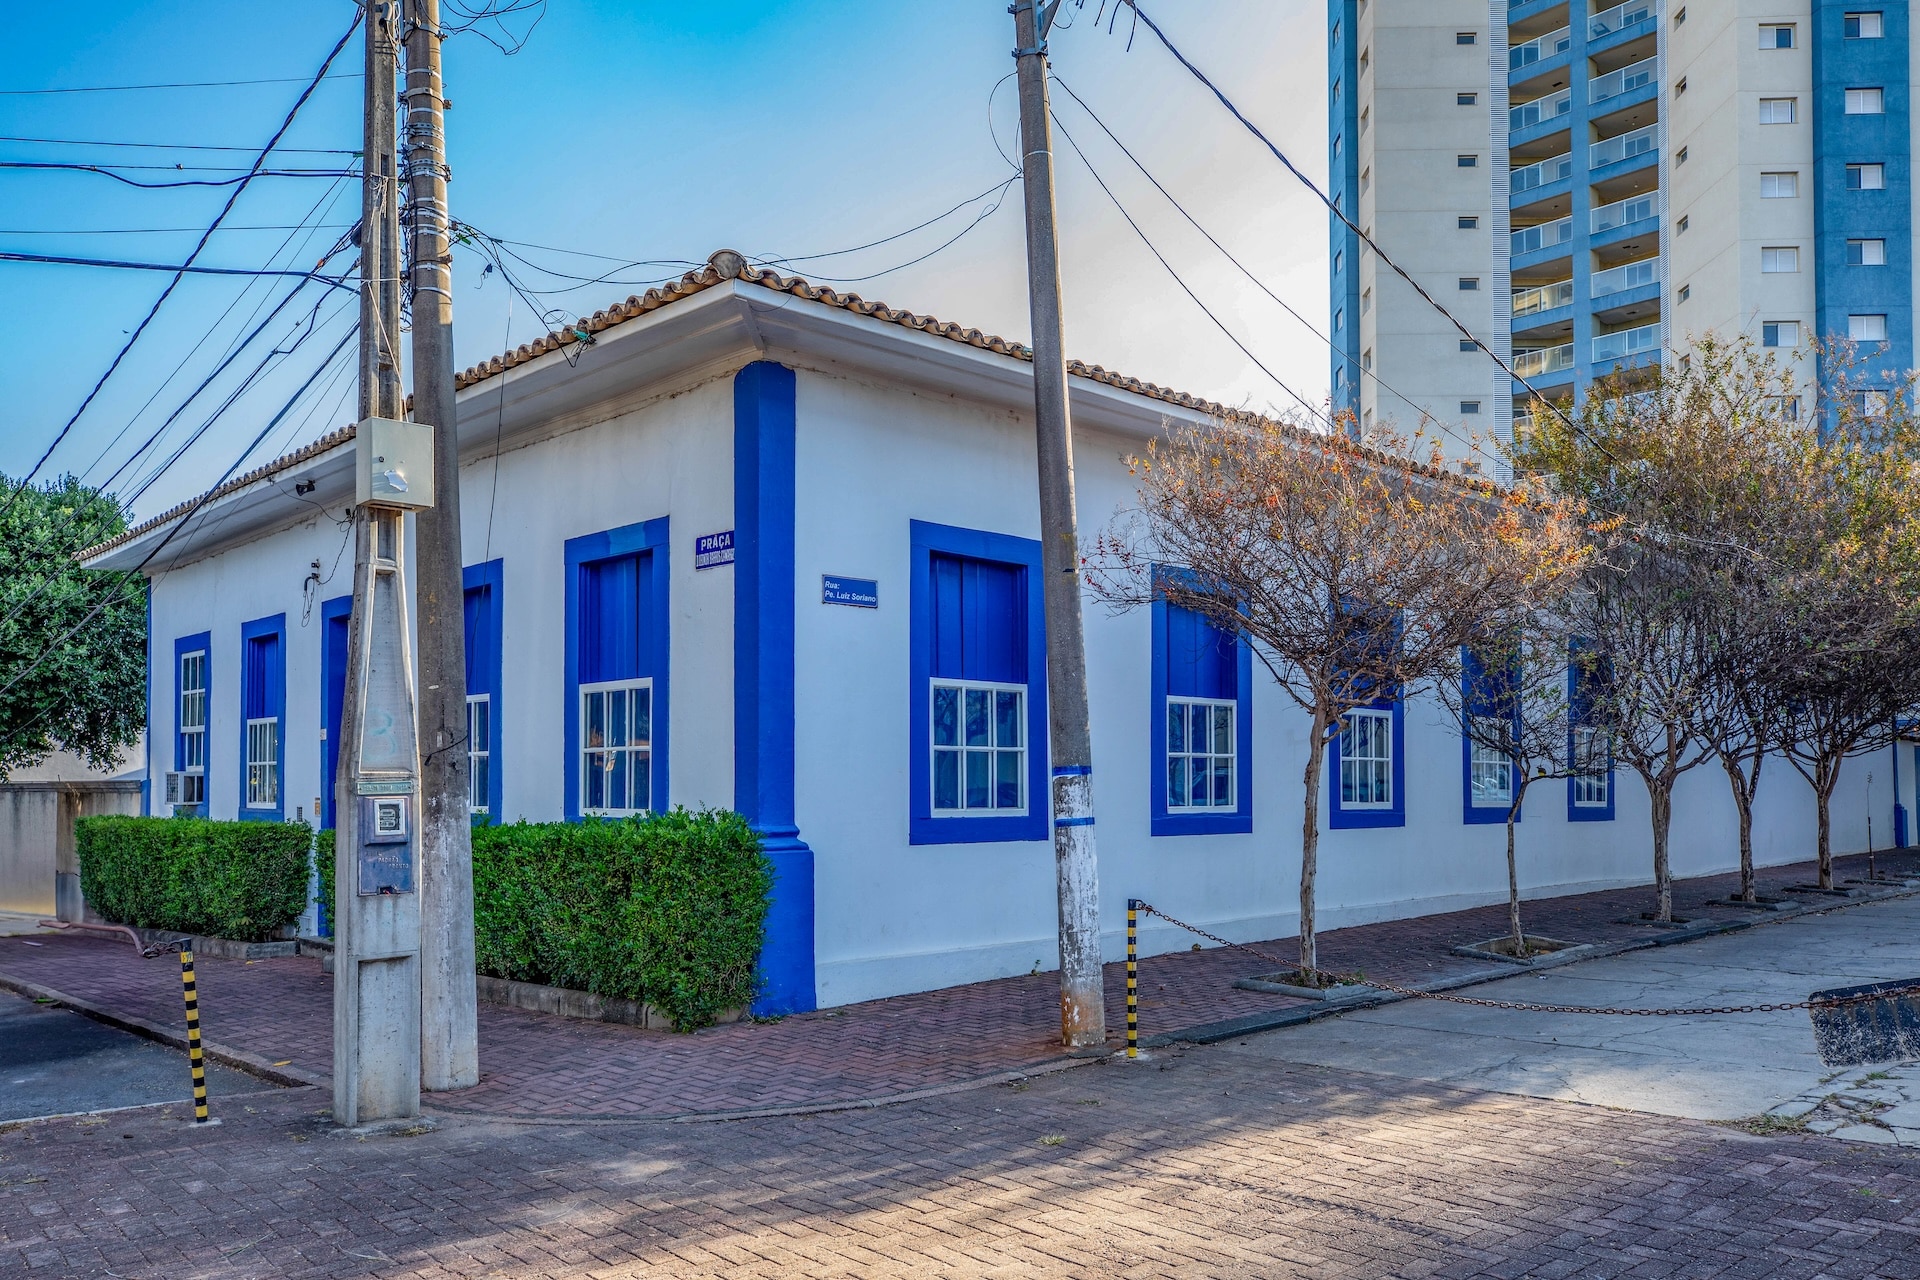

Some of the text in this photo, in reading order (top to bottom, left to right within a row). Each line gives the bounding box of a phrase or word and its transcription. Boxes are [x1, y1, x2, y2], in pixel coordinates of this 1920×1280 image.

[825, 581, 840, 589] Rua:
[825, 590, 876, 602] Pe. Luiz Soriano
